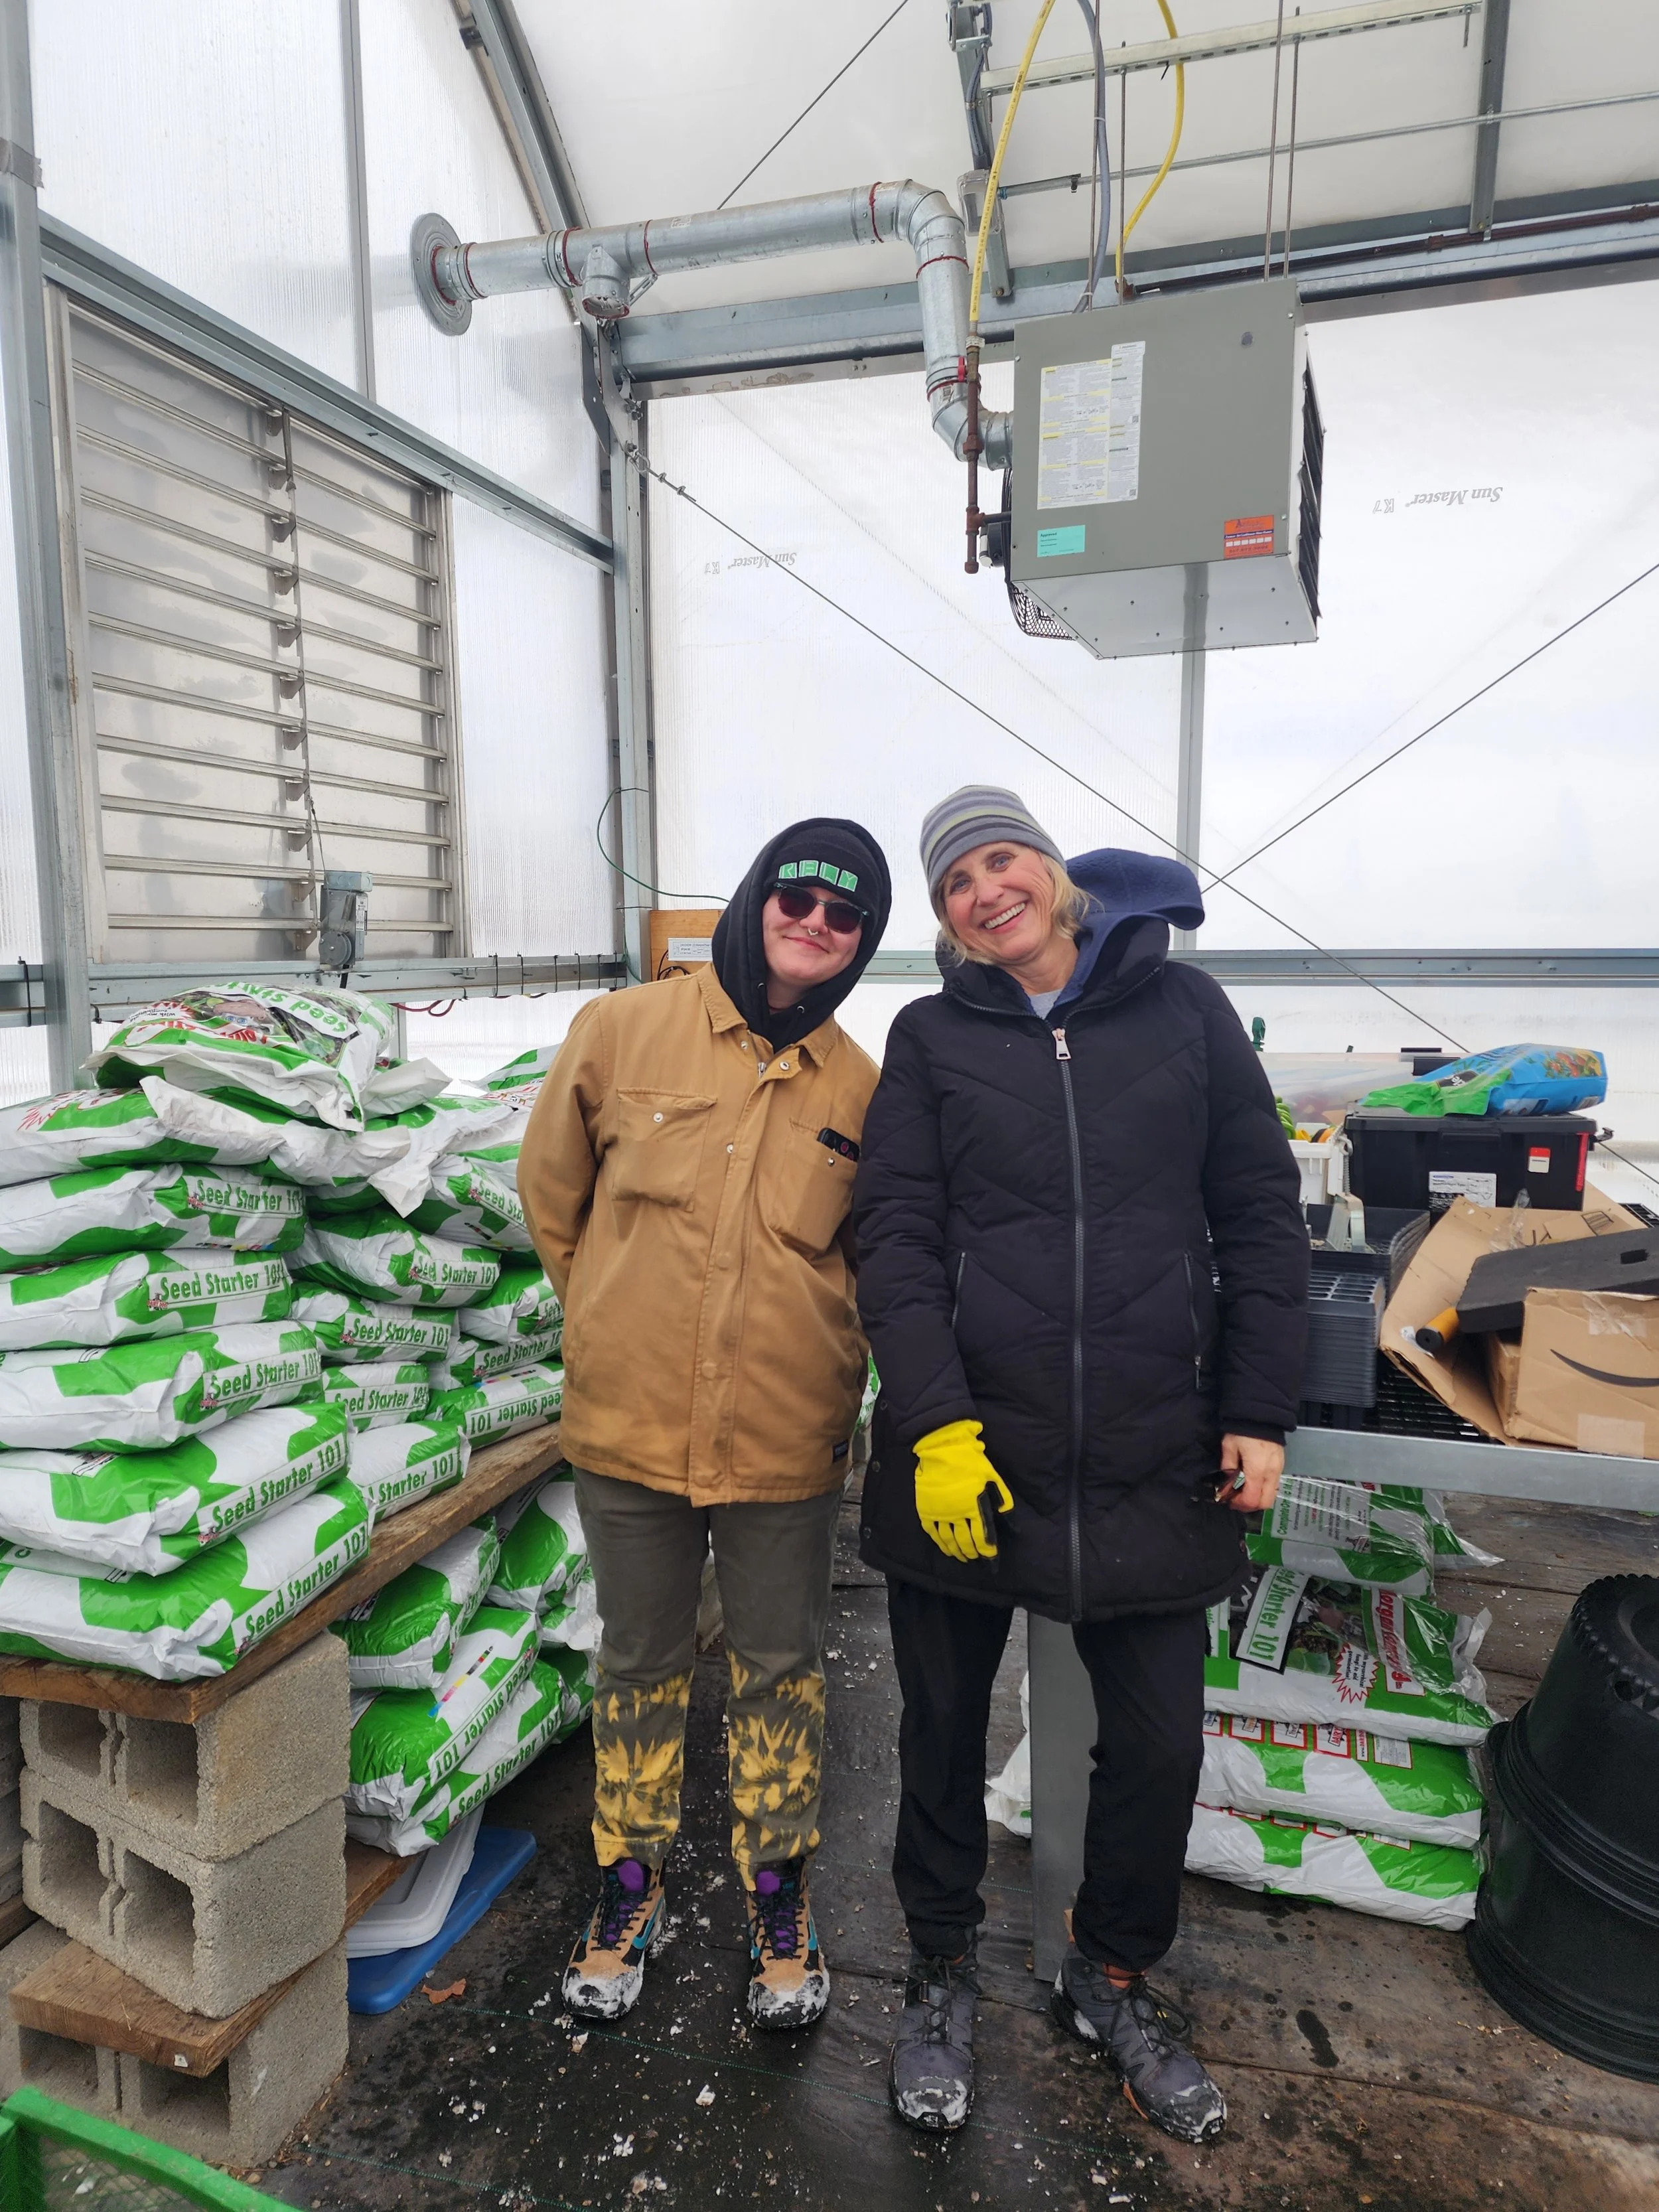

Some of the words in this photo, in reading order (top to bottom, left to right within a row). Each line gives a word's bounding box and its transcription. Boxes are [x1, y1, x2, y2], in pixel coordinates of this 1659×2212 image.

[1471, 486, 1503, 502] Sun
[774, 552, 797, 565] Sun
[197, 1180, 233, 1206] Seed
[235, 1186, 282, 1211] Starter
[478, 1179, 505, 1211] Seed
[160, 1272, 202, 1300] Seed
[205, 1271, 259, 1295] Starter
[442, 1263, 477, 1284] Starter
[481, 1266, 496, 1285] 101
[352, 1318, 383, 1340] Seed
[386, 1321, 427, 1344] Starter
[431, 1325, 449, 1347] 101
[483, 1344, 512, 1370] Seed
[512, 1337, 547, 1361] Starter
[550, 1330, 562, 1348] 10
[210, 1364, 252, 1399] Seed
[256, 1360, 300, 1388] Starter
[302, 1350, 321, 1376] 101
[368, 1387, 409, 1410] Starter
[498, 1399, 538, 1423] Starter
[539, 1392, 562, 1416] eed
[470, 1415, 491, 1436] 101
[212, 1487, 255, 1529] Seed
[259, 1461, 313, 1507] Starter
[317, 1439, 341, 1472] 101
[378, 1470, 427, 1505] Starter
[433, 1453, 453, 1479] 101
[245, 1588, 285, 1638] Seed
[287, 1554, 339, 1607] Starter
[343, 1526, 366, 1560] 101
[1275, 1569, 1301, 1588] ed
[1260, 1584, 1295, 1629] Starter
[1249, 1633, 1280, 1661] 101
[1353, 1654, 1362, 1666] fungi
[506, 1660, 528, 1703] Seed
[464, 1692, 504, 1747] Starter
[436, 1739, 460, 1779] 101
[458, 1776, 490, 1813] Seed
[494, 1736, 538, 1783] Starter
[541, 1706, 563, 1742] 101
